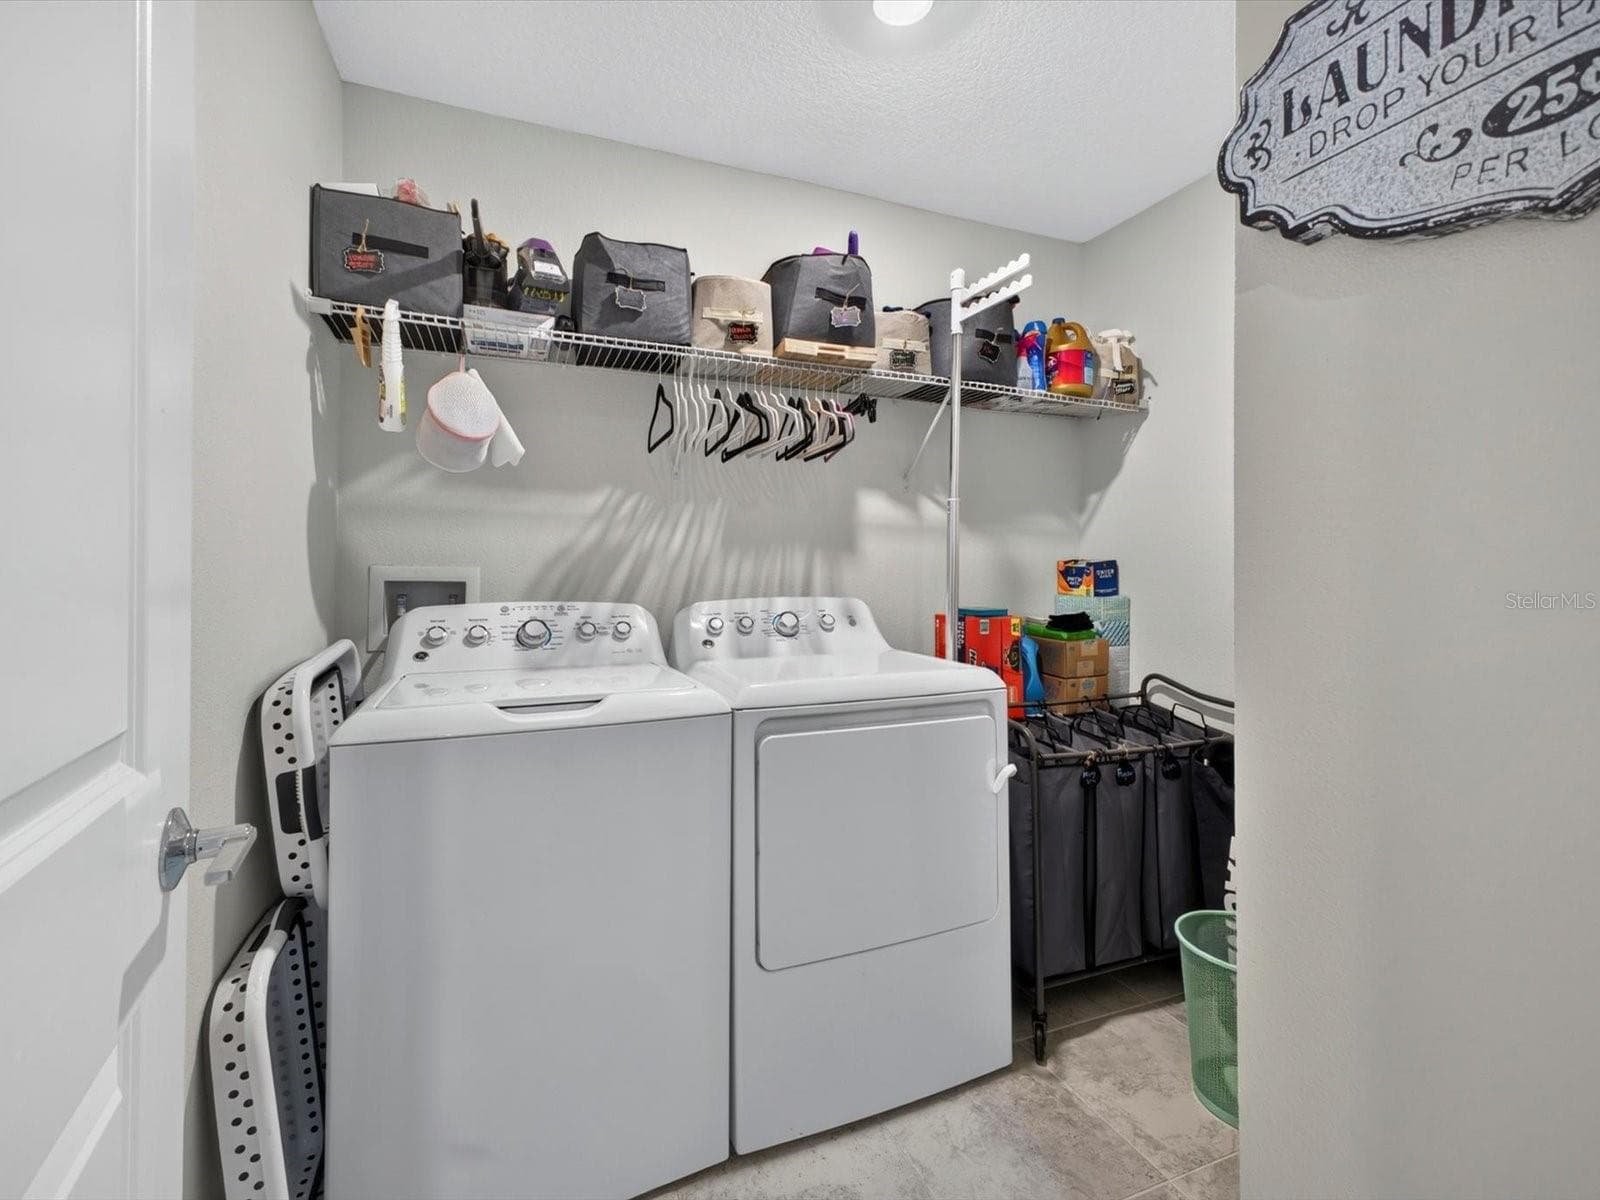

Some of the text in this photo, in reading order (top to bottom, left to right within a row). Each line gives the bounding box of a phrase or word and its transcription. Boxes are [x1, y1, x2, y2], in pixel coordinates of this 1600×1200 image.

[1281, 0, 1515, 138] LAUND
[1309, 87, 1404, 158] DROP
[1418, 15, 1537, 97] YOUR
[1450, 147, 1529, 190] PER
